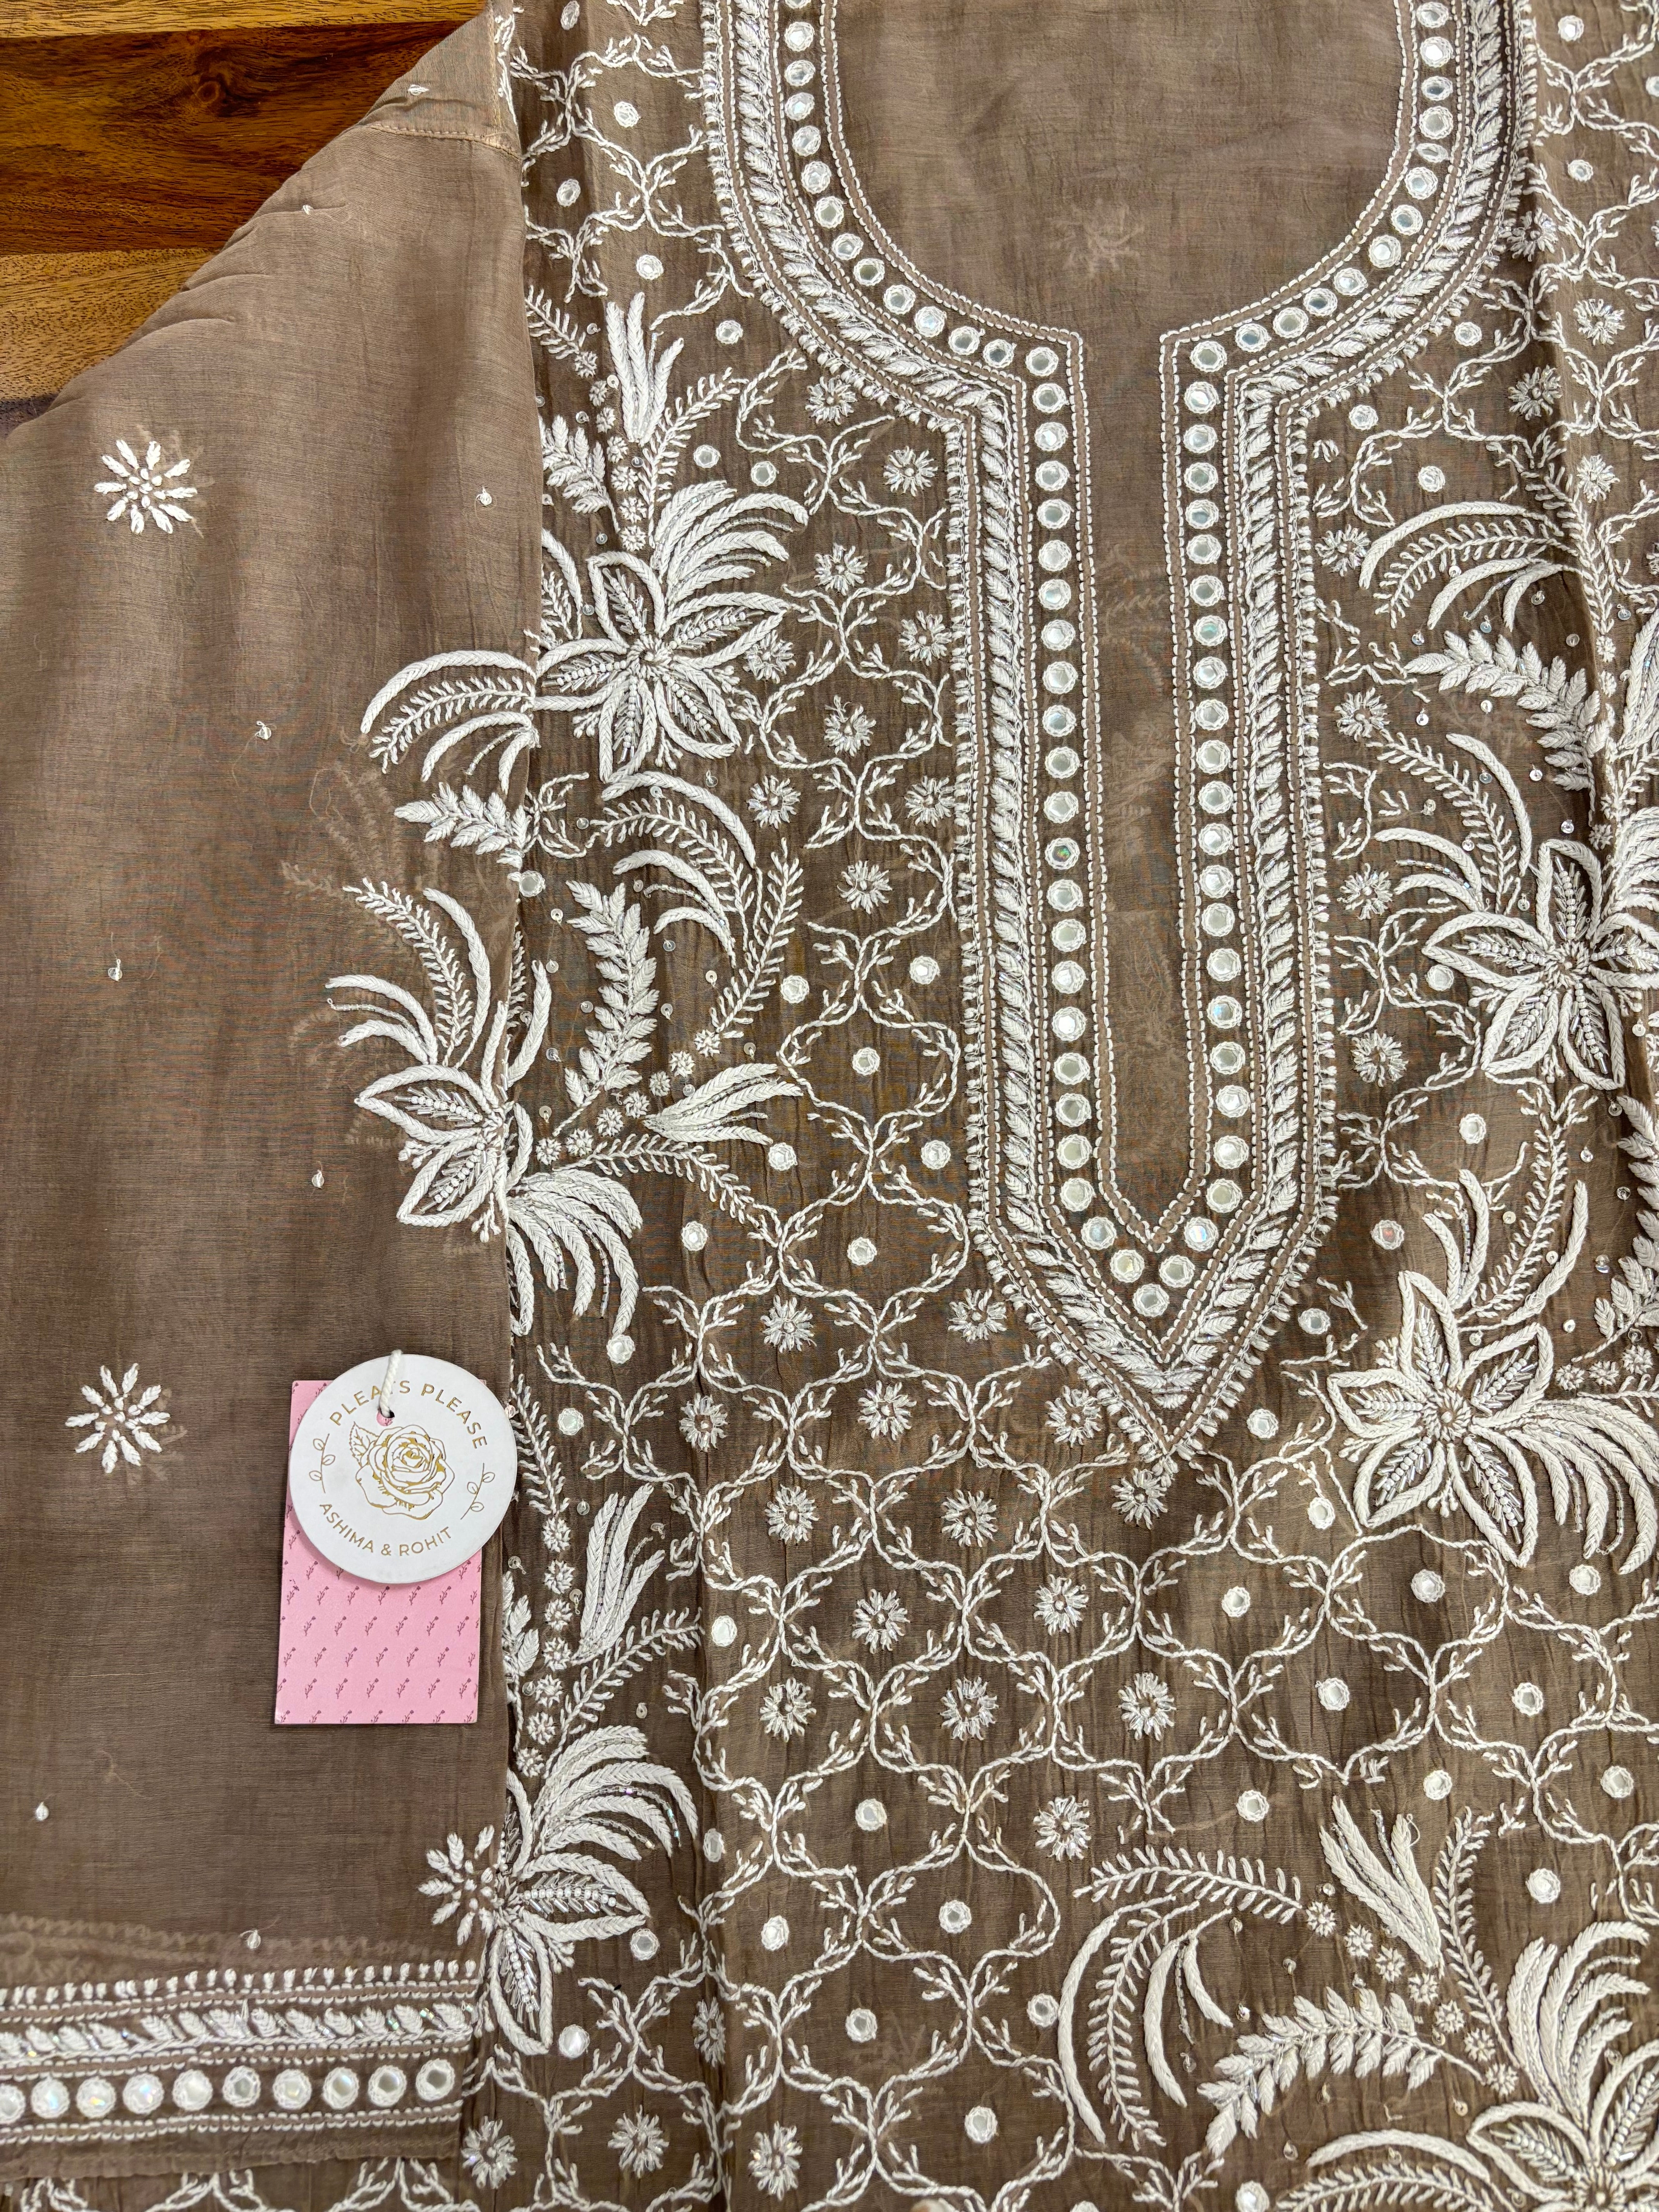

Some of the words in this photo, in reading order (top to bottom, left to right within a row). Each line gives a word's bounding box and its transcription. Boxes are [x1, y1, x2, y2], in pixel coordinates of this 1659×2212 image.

[330, 1380, 410, 1425] PLEAS
[421, 1383, 487, 1449] PLEASE
[319, 1504, 373, 1553] ASHIMA
[381, 1544, 391, 1556] &
[399, 1527, 452, 1556] ROHIT
